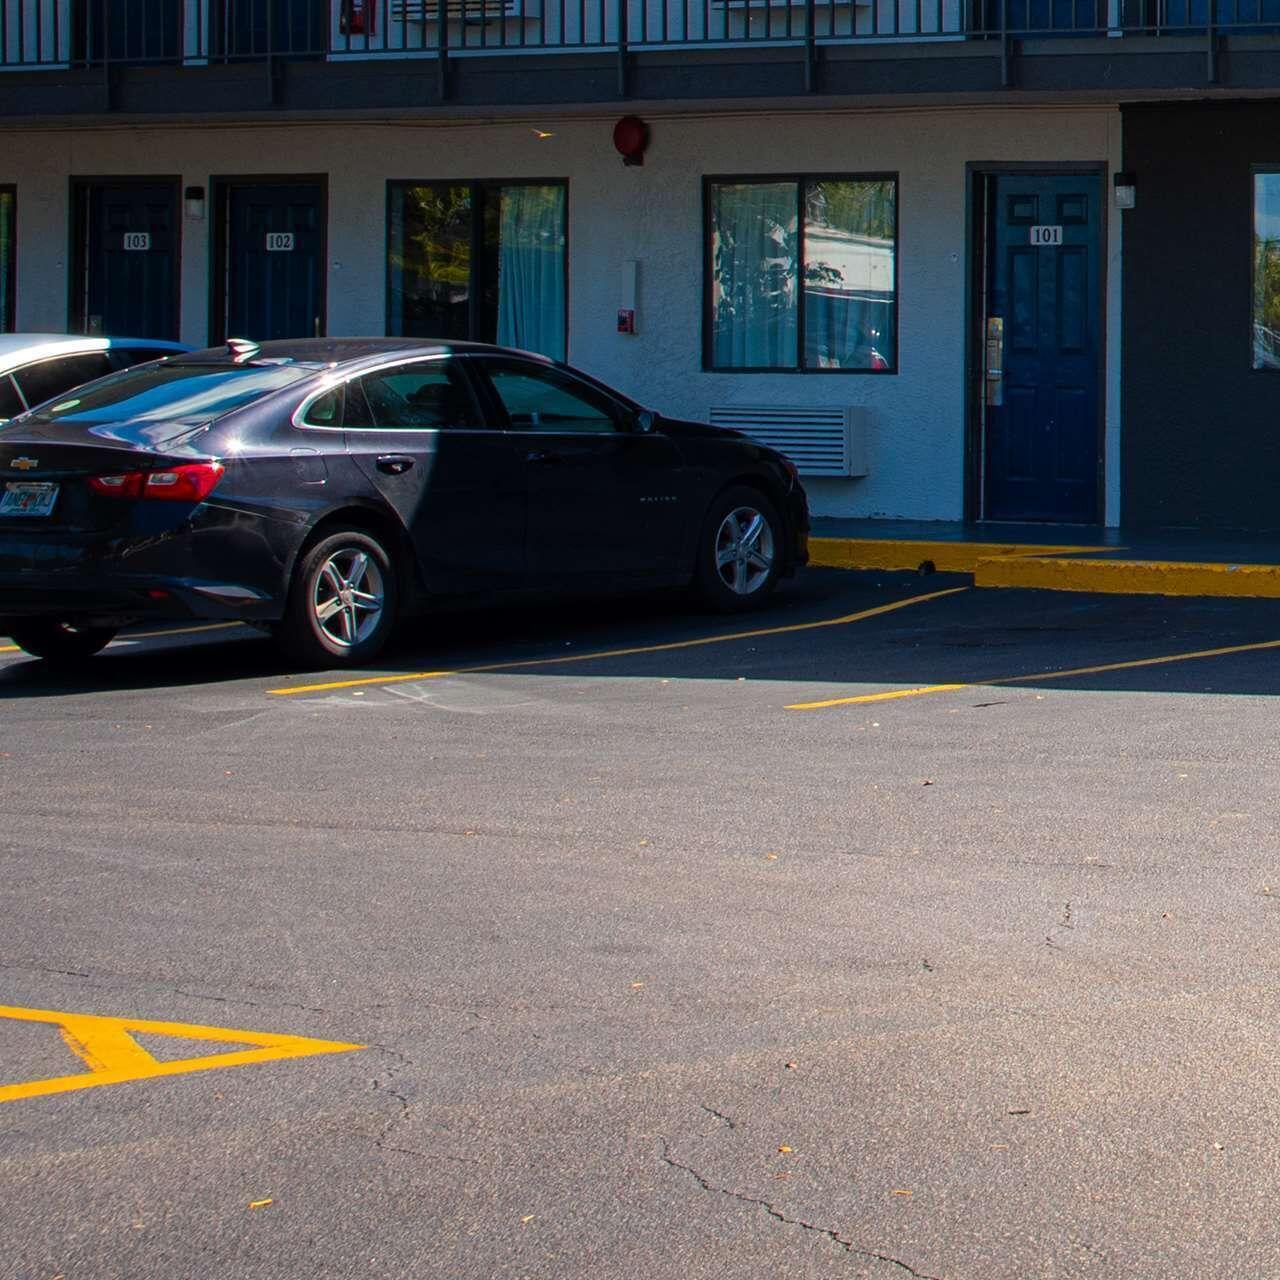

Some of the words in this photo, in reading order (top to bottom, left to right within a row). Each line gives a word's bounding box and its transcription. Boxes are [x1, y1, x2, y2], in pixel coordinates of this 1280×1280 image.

[126, 234, 147, 249] 103
[269, 234, 290, 249] 102
[1035, 228, 1058, 243] 101
